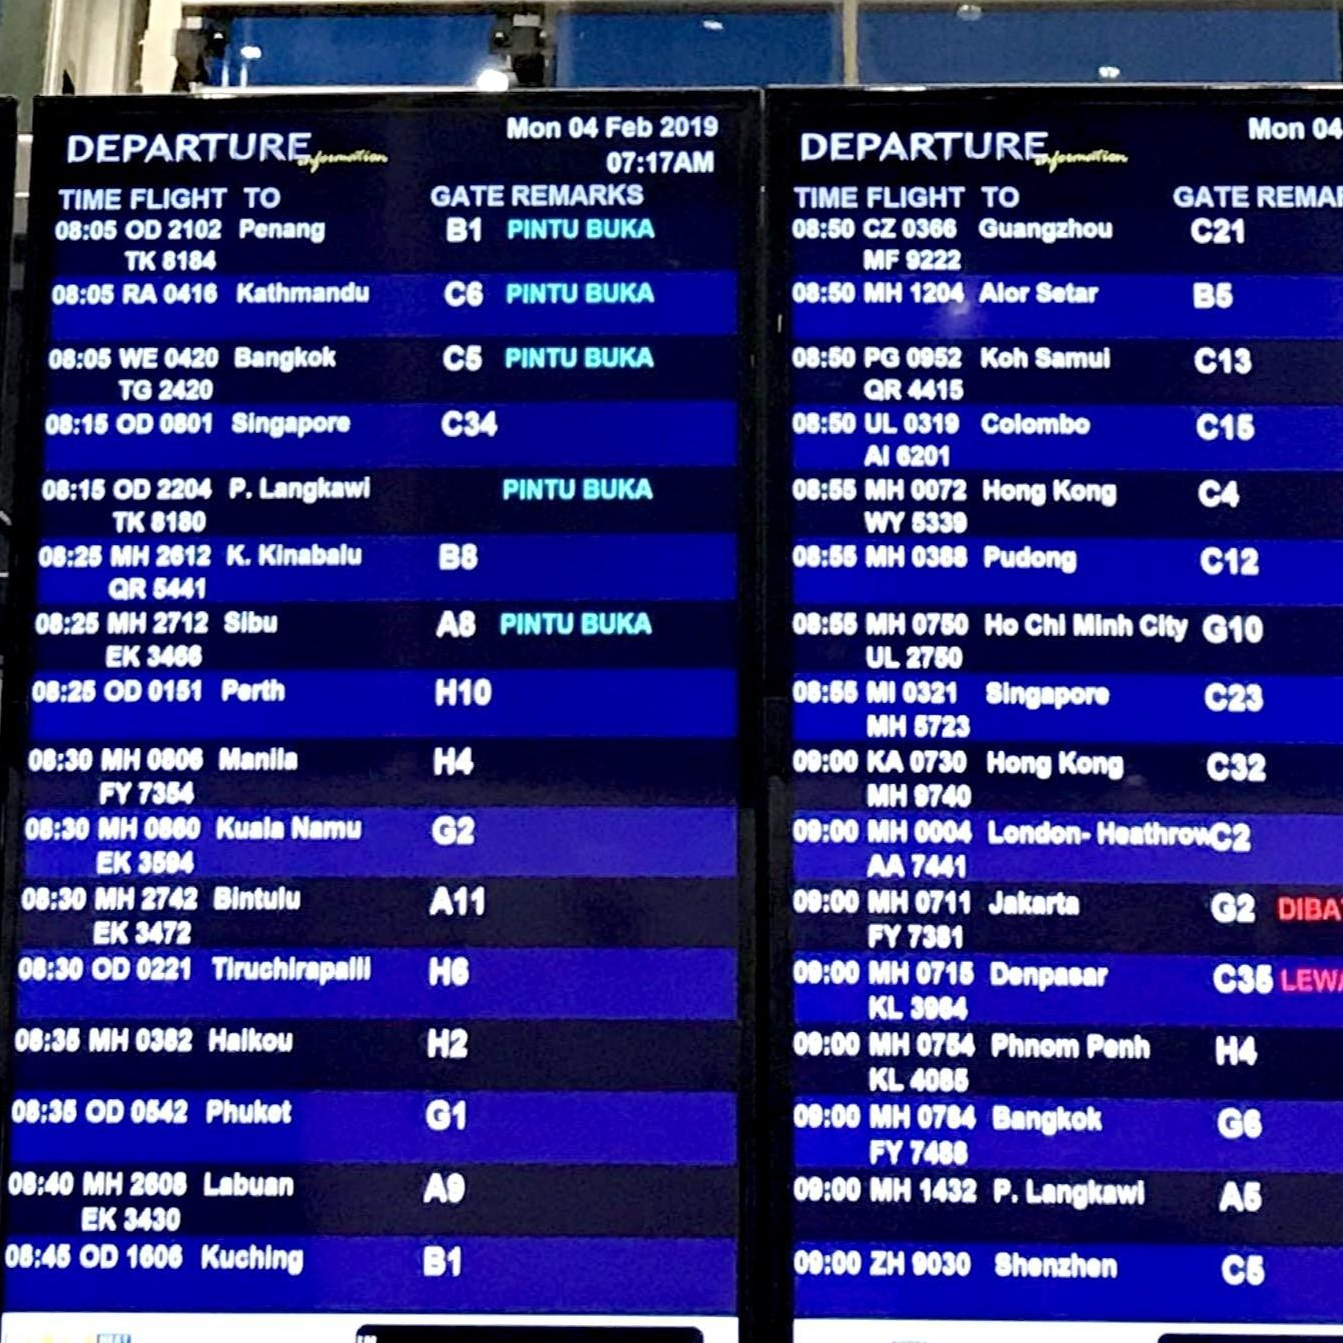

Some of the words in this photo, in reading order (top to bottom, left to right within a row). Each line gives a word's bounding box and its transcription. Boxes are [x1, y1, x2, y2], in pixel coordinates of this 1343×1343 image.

[507, 117, 561, 138] Mon
[569, 117, 598, 138] 04
[606, 117, 652, 138] Feb
[660, 116, 718, 137] 2019
[1249, 118, 1304, 139] Mon
[1313, 118, 1343, 139] 04
[68, 133, 311, 163] DEPARTURE
[802, 132, 1048, 161] DEPARTURE
[607, 151, 714, 173] 07:17AM
[59, 189, 121, 210] TIME
[131, 188, 227, 209] FLIGHT
[244, 187, 280, 208] TO
[431, 185, 504, 206] GATE
[512, 184, 643, 206] REMARKS
[794, 187, 858, 208] TIME
[867, 187, 965, 208] FLIGHT
[981, 186, 1019, 207] TO
[1173, 186, 1249, 207] GATE
[56, 220, 117, 240] 08:05
[125, 220, 161, 239] OD
[168, 219, 221, 239] 2102
[240, 219, 325, 243] Penang
[447, 217, 481, 242] B1
[508, 219, 578, 239] PINTU
[587, 219, 655, 239] BUKA
[792, 218, 855, 238] 08:50
[863, 218, 896, 238] CZ
[902, 218, 957, 238] 0366
[979, 218, 1112, 243] Guangzhou
[1191, 218, 1244, 243] C21
[125, 251, 155, 271] TK
[163, 250, 216, 270] 8184
[864, 249, 899, 270] MF
[906, 249, 961, 270] 9222
[123, 284, 157, 304] RA
[164, 283, 217, 304] 0416
[237, 282, 369, 303] Kathmandu
[445, 281, 483, 307] C6
[981, 347, 1028, 368] Koh
[1036, 347, 1110, 368] Samui
[1195, 347, 1252, 374] C13
[232, 412, 350, 438] Singapore
[442, 411, 497, 437] C34
[230, 478, 252, 499] P.
[260, 477, 370, 503] Langkawi
[983, 479, 1046, 506] Hong
[1053, 479, 1116, 506] Kong
[1199, 480, 1239, 507] C4
[984, 545, 1076, 573] Pudong
[1201, 547, 1259, 575] C12
[222, 679, 285, 701] Perth
[436, 678, 491, 706] H10
[217, 817, 284, 839] Kuala
[292, 816, 361, 839] Namu
[432, 816, 475, 845] G2
[429, 886, 484, 915] A11
[989, 891, 1079, 915] Jakarta
[1211, 893, 1255, 923] G2
[992, 1033, 1079, 1058] Phnom
[1087, 1034, 1150, 1058] Penh
[1216, 1036, 1257, 1065] H4
[202, 1244, 303, 1275] Kuching
[424, 1246, 461, 1276] B1
[995, 1252, 1117, 1278] Shenzhen
